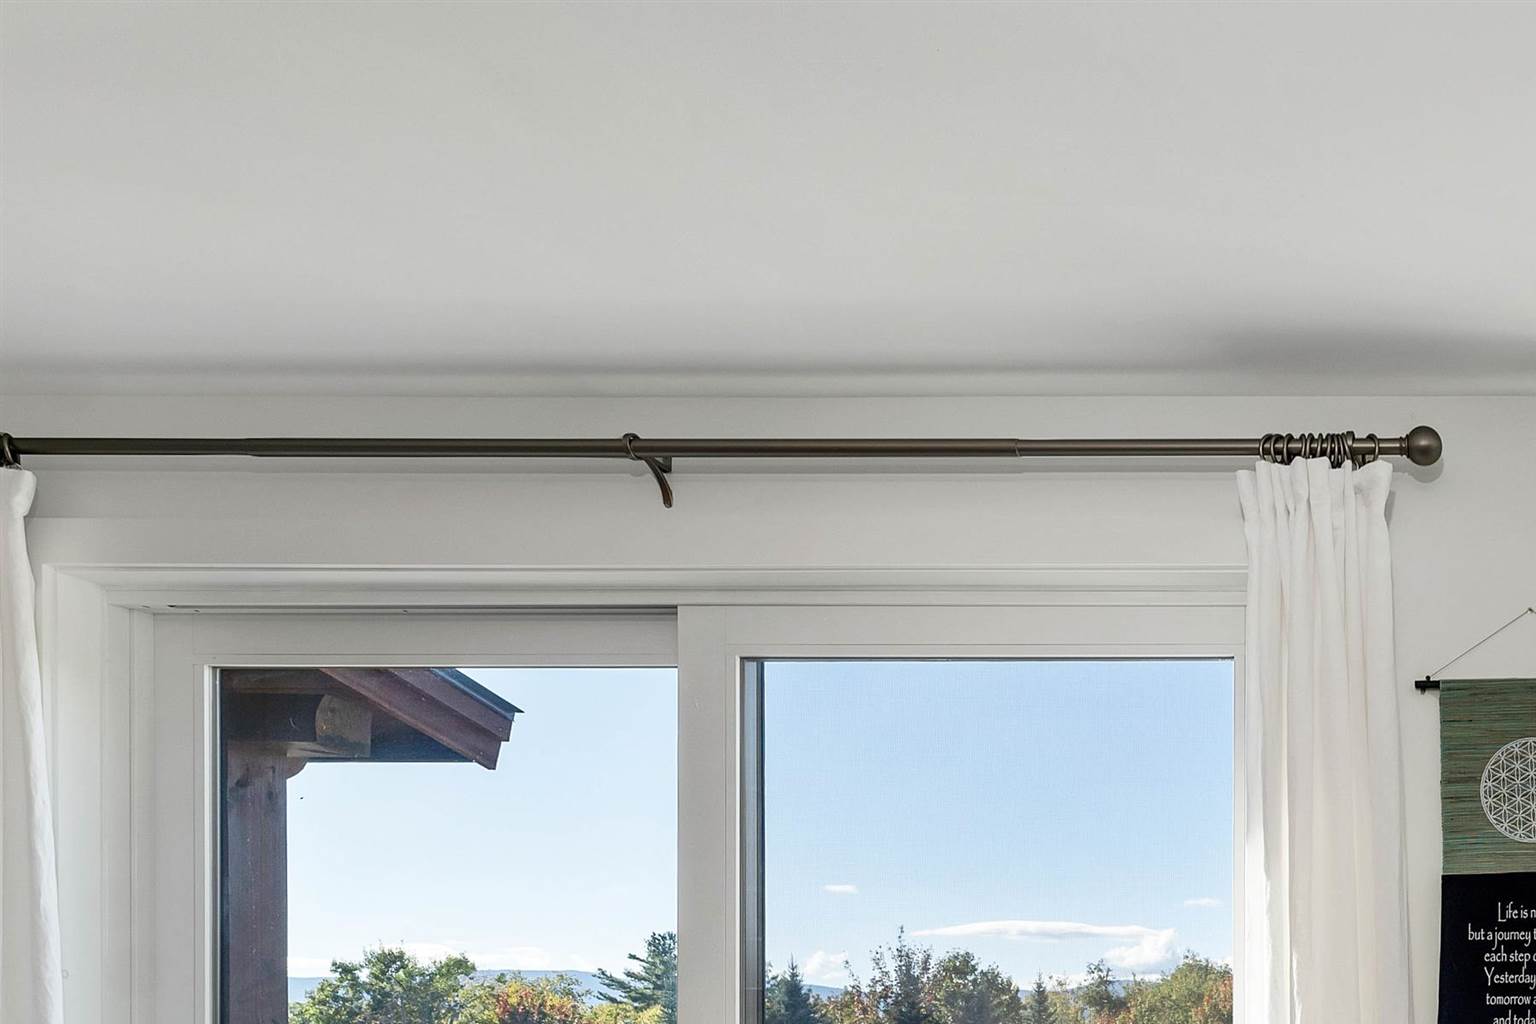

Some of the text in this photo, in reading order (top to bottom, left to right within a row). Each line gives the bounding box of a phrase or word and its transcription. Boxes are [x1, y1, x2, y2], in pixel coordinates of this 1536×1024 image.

[1498, 901, 1519, 922] Life
[1520, 905, 1529, 919] is
[1468, 923, 1486, 941] but
[1486, 931, 1493, 941] a
[1492, 926, 1532, 951] journey
[1484, 944, 1508, 963] each
[1509, 949, 1532, 970] step
[1484, 966, 1536, 990] Yesterday
[1486, 993, 1532, 1006] tomorrow
